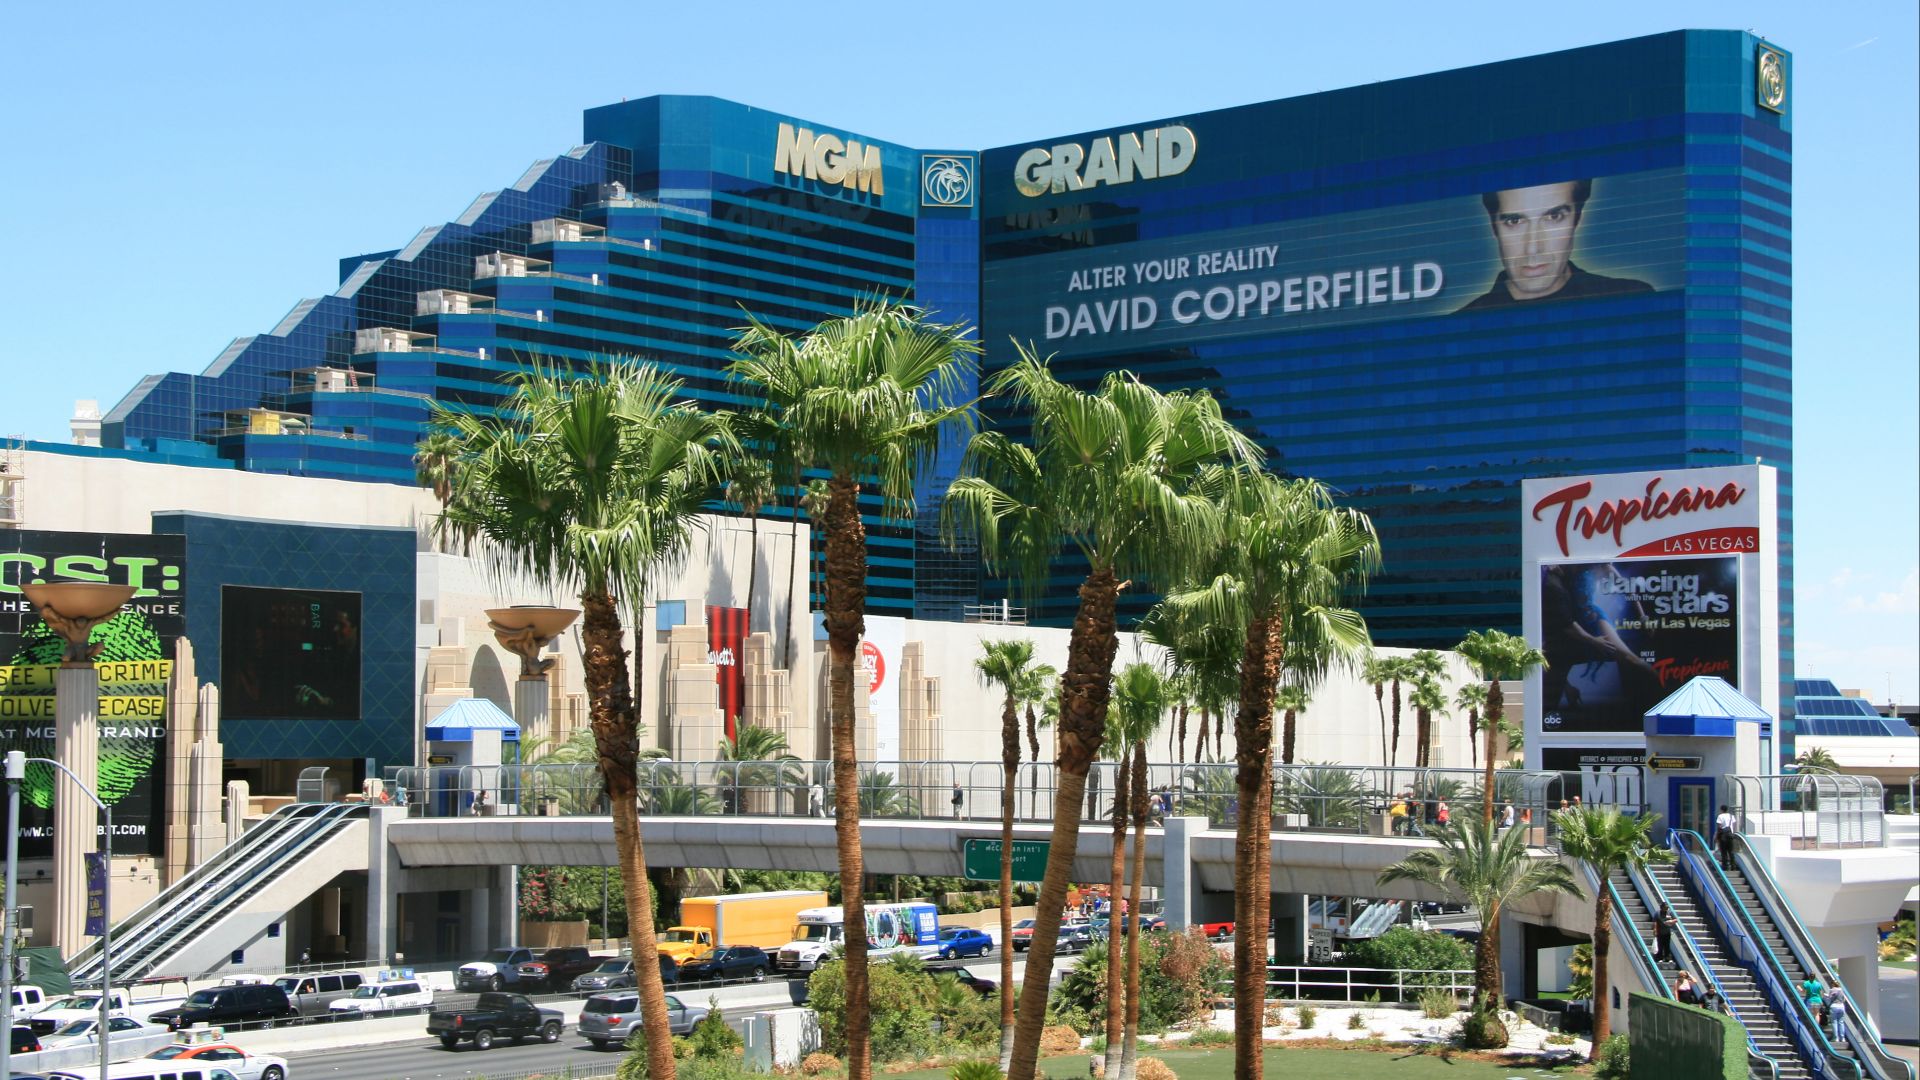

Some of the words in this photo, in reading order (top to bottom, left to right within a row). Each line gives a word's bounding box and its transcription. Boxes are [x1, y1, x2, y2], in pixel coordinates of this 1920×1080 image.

[775, 122, 884, 195] MGM
[1014, 125, 1197, 197] GRAND
[1068, 270, 1126, 292] ALTER
[1133, 257, 1189, 284] YOUR
[1197, 245, 1279, 275] REALITY
[1046, 296, 1157, 339] DAVID
[1171, 262, 1443, 324] COPPERFIELD
[1533, 477, 1746, 557] Tropicana
[1664, 538, 1692, 552] LAS
[1698, 536, 1754, 551] VEGAS
[1600, 570, 1699, 597] dancing
[0, 601, 30, 612] HE
[1625, 593, 1641, 601] with
[1643, 592, 1655, 601] the
[1654, 591, 1729, 614] stars
[1615, 618, 1641, 630] Live
[1645, 618, 1658, 629] in
[1661, 617, 1685, 629] Las
[1688, 616, 1730, 630] Vegas
[0, 667, 35, 687] SEE
[100, 662, 169, 682] CRIME
[1650, 657, 1729, 688] Tropicana
[112, 698, 162, 717] CASE
[1544, 715, 1561, 724] abc
[26, 727, 56, 738] MG
[97, 727, 166, 738] RAND
[1315, 946, 1330, 957] 35
